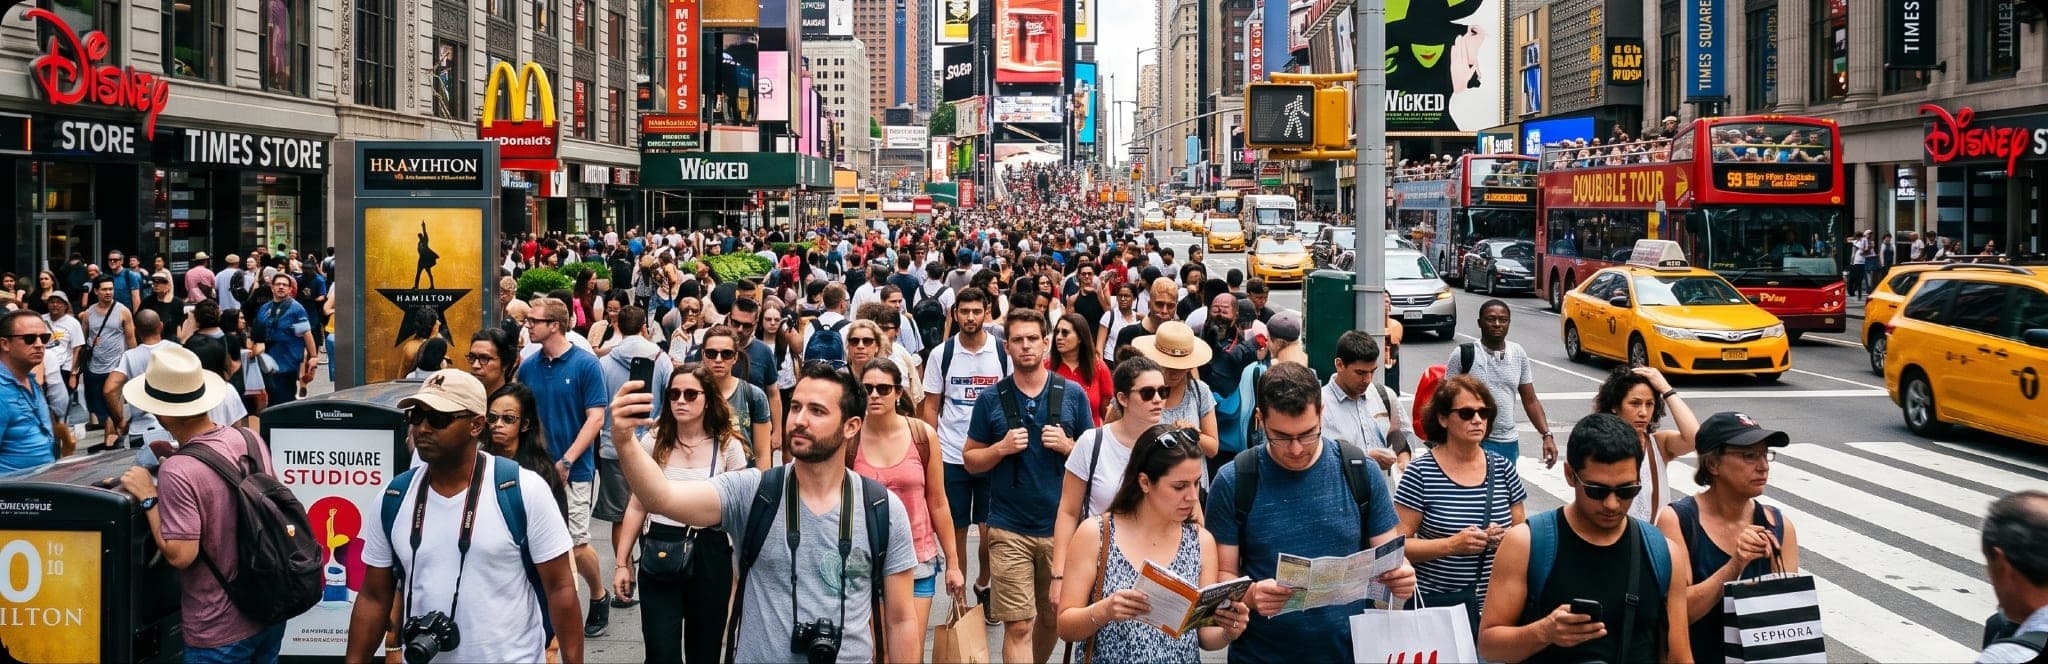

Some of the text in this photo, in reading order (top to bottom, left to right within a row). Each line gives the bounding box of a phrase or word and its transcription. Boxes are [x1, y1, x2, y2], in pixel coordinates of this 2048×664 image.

[1904, 1, 1920, 54] TIMES
[1699, 0, 1712, 91] TIMES SQUARE
[61, 120, 135, 154] STORE
[185, 128, 323, 169] TIMES STORE
[1629, 170, 1664, 202] TOUR
[396, 294, 453, 302] HAMILTON
[283, 450, 381, 467] TIMES SQUARE
[283, 468, 382, 486] STUDIOS
[1752, 625, 1813, 643] SEPHORA
